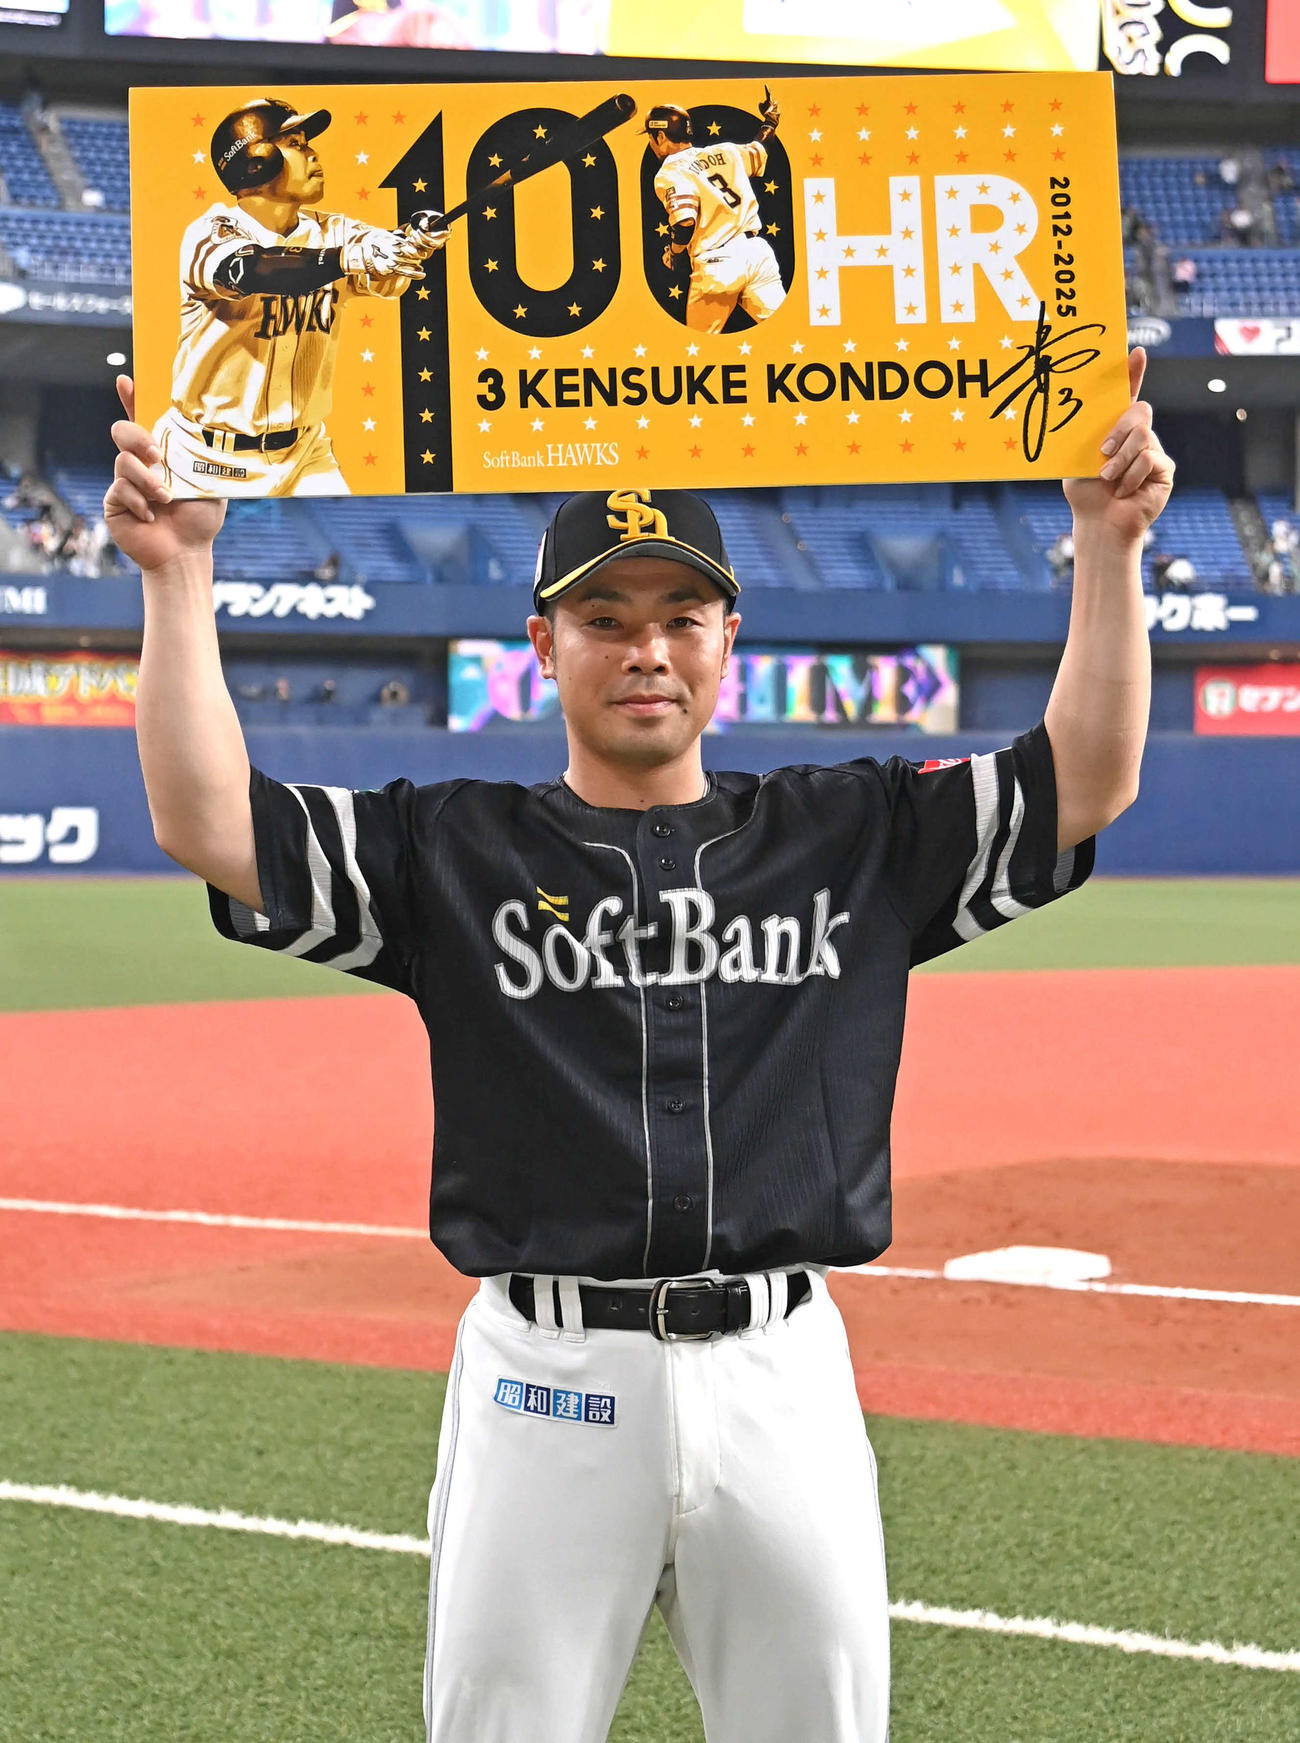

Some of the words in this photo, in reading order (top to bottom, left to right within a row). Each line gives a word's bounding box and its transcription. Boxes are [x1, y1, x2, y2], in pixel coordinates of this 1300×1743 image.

[223, 130, 257, 162] SoftBank
[706, 173, 742, 209] 3
[1049, 176, 1077, 318] 2012-2025
[476, 367, 507, 412] 3
[518, 364, 749, 409] KENSUKE
[766, 358, 990, 404] KONDOH
[482, 450, 545, 469] SoftBank
[546, 442, 620, 467] HAWKS
[491, 887, 851, 1000] SoftBank
[496, 1380, 613, 1423] 昭和建設
